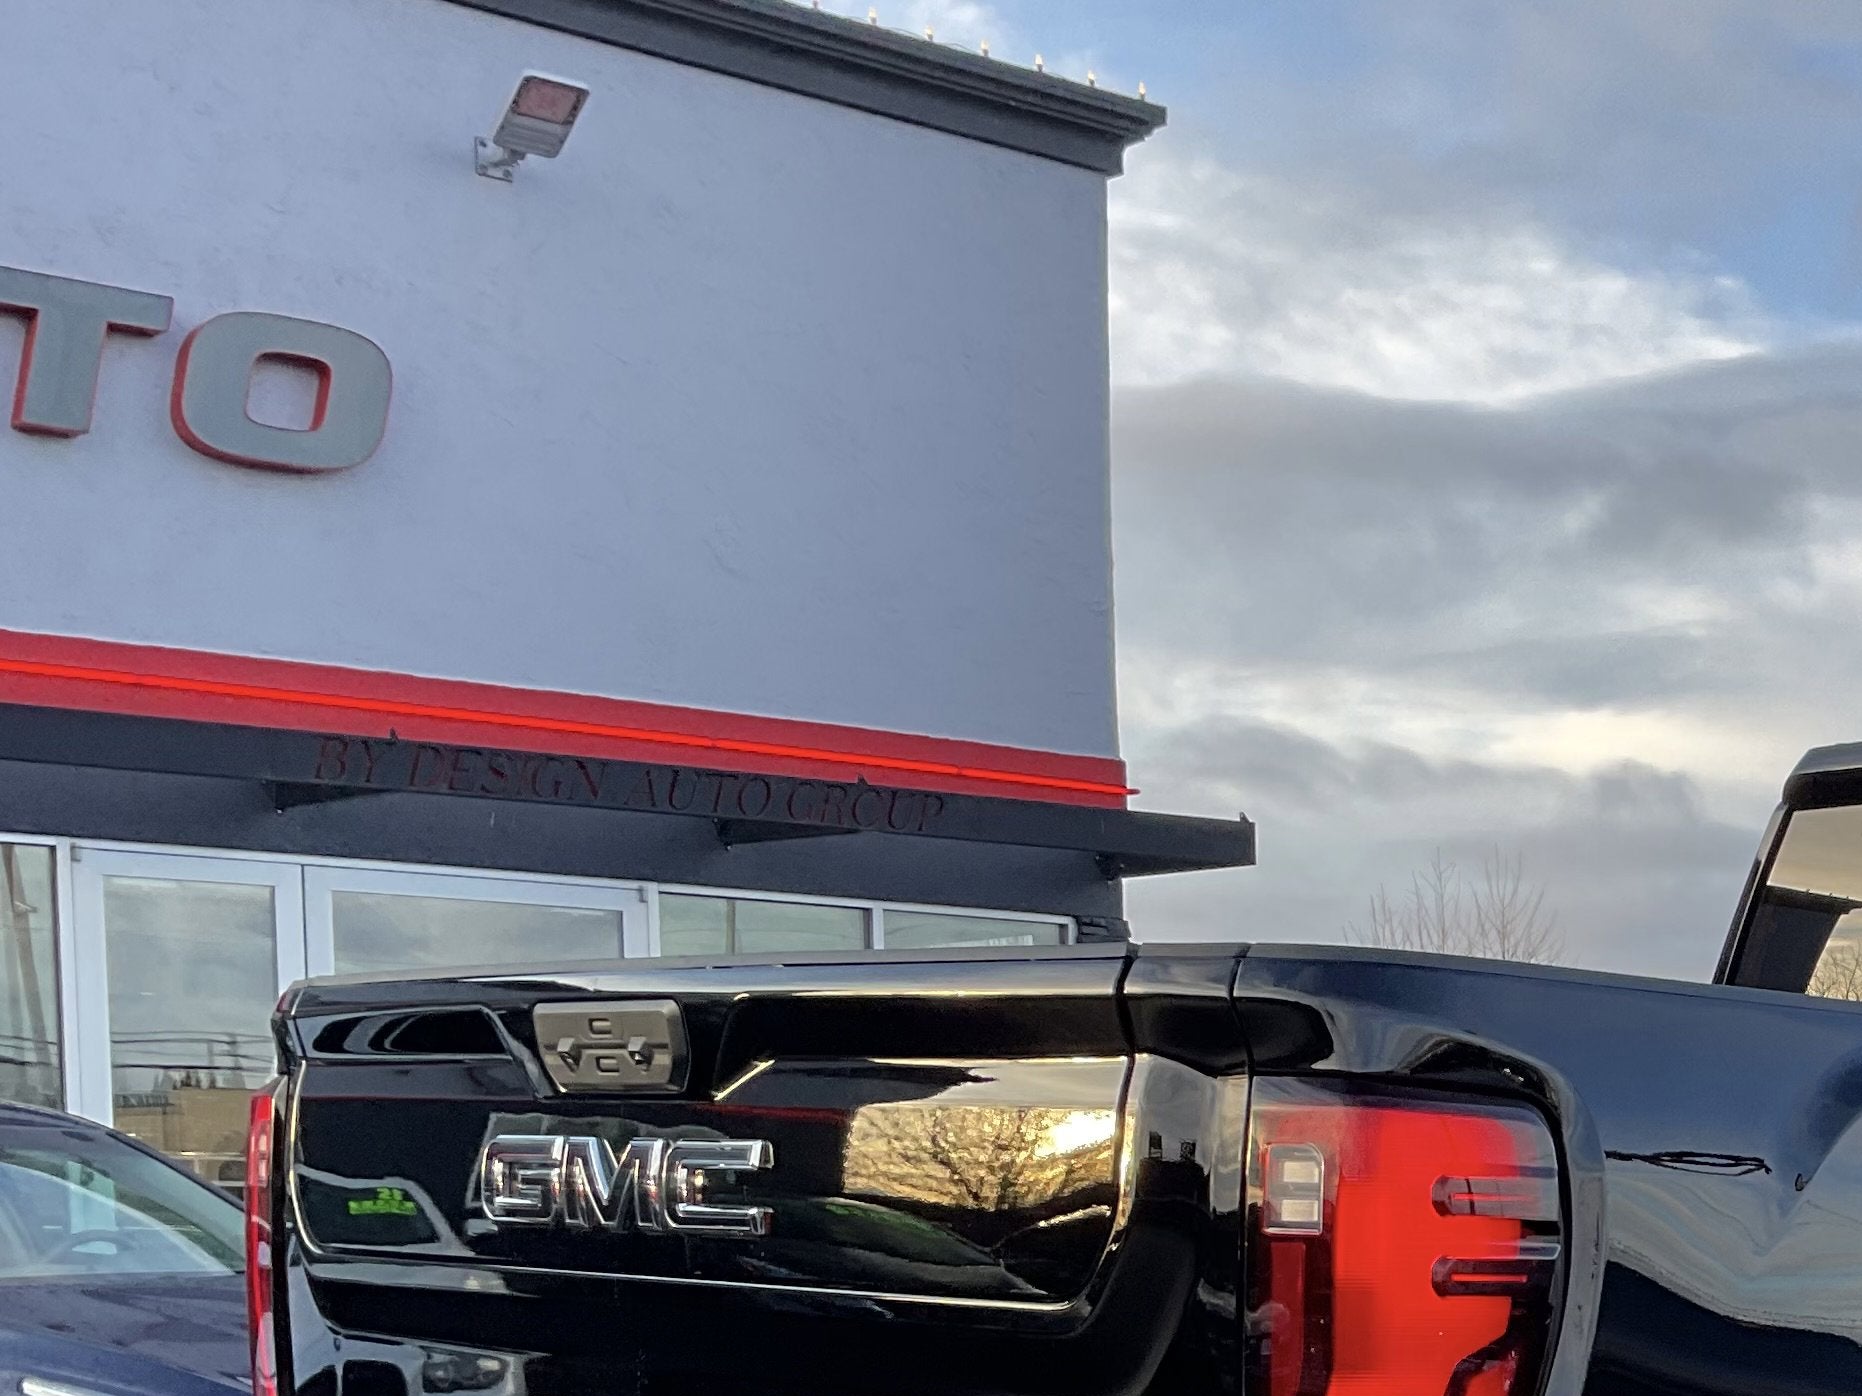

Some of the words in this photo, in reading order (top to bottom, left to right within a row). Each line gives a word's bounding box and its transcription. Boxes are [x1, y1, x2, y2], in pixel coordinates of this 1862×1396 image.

[314, 735, 381, 784] BY
[407, 740, 603, 801] DESIGN
[623, 767, 772, 818] AUTO
[786, 782, 946, 833] GROUP
[480, 1134, 774, 1236] GMC
